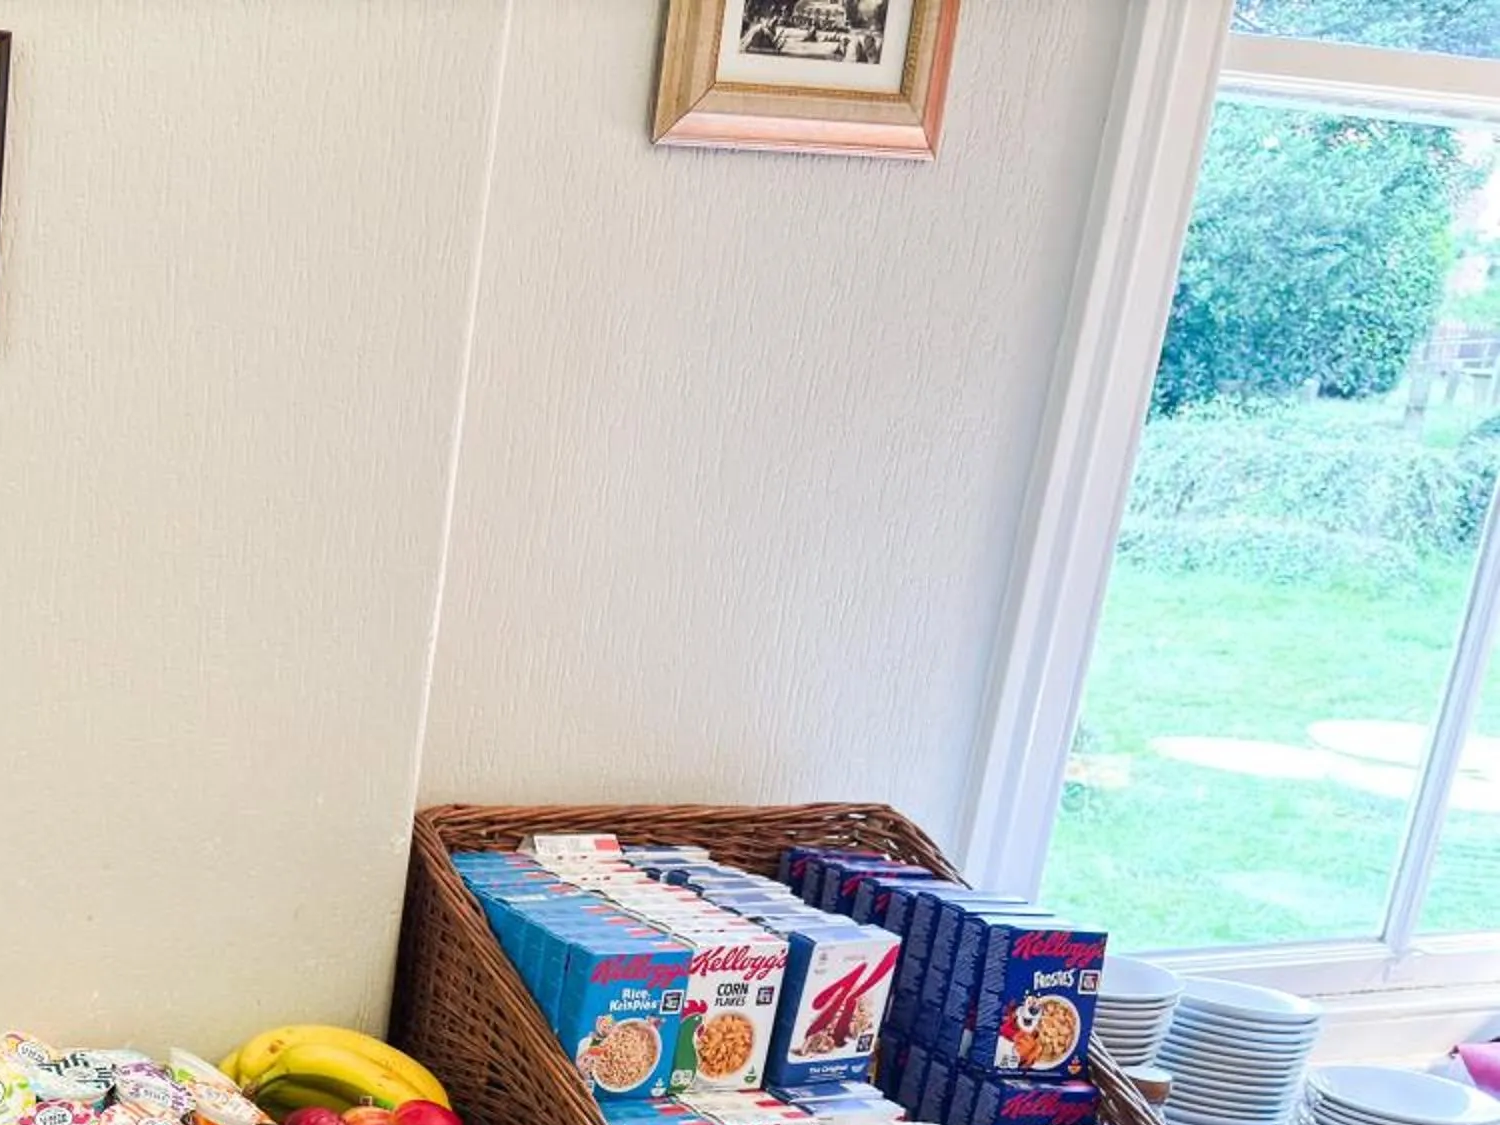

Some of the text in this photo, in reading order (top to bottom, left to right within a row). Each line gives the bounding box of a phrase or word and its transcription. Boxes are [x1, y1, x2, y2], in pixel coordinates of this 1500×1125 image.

[688, 945, 787, 981] Kellogg's
[622, 988, 649, 1000] Rice
[717, 983, 749, 996] CORN
[609, 1000, 657, 1012] Krispies
[714, 997, 747, 1007] FLAKES
